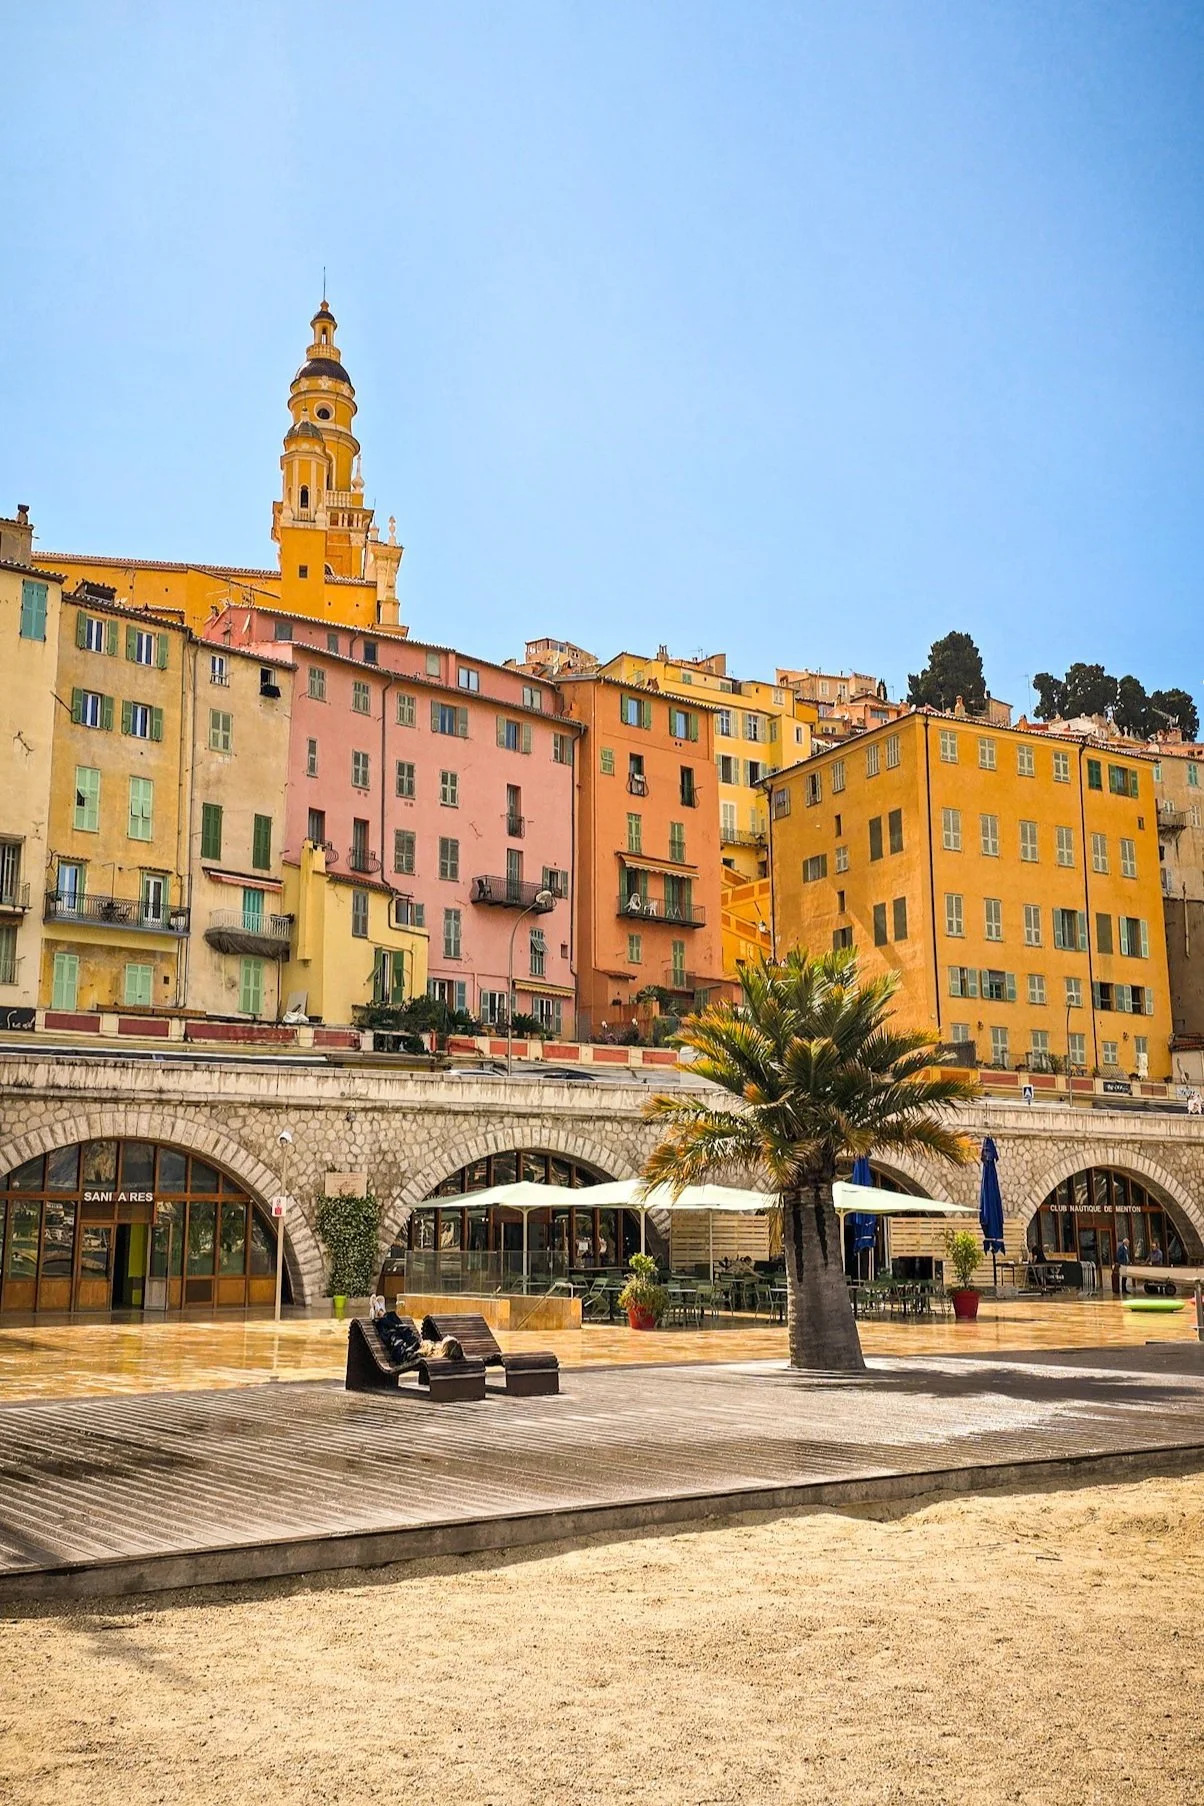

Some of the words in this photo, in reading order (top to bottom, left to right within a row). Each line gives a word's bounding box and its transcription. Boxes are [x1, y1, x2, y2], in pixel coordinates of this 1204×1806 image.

[1050, 1204, 1067, 1212] CLUB
[1070, 1204, 1101, 1213] NAUTIQUE
[1115, 1204, 1141, 1213] MENTON
